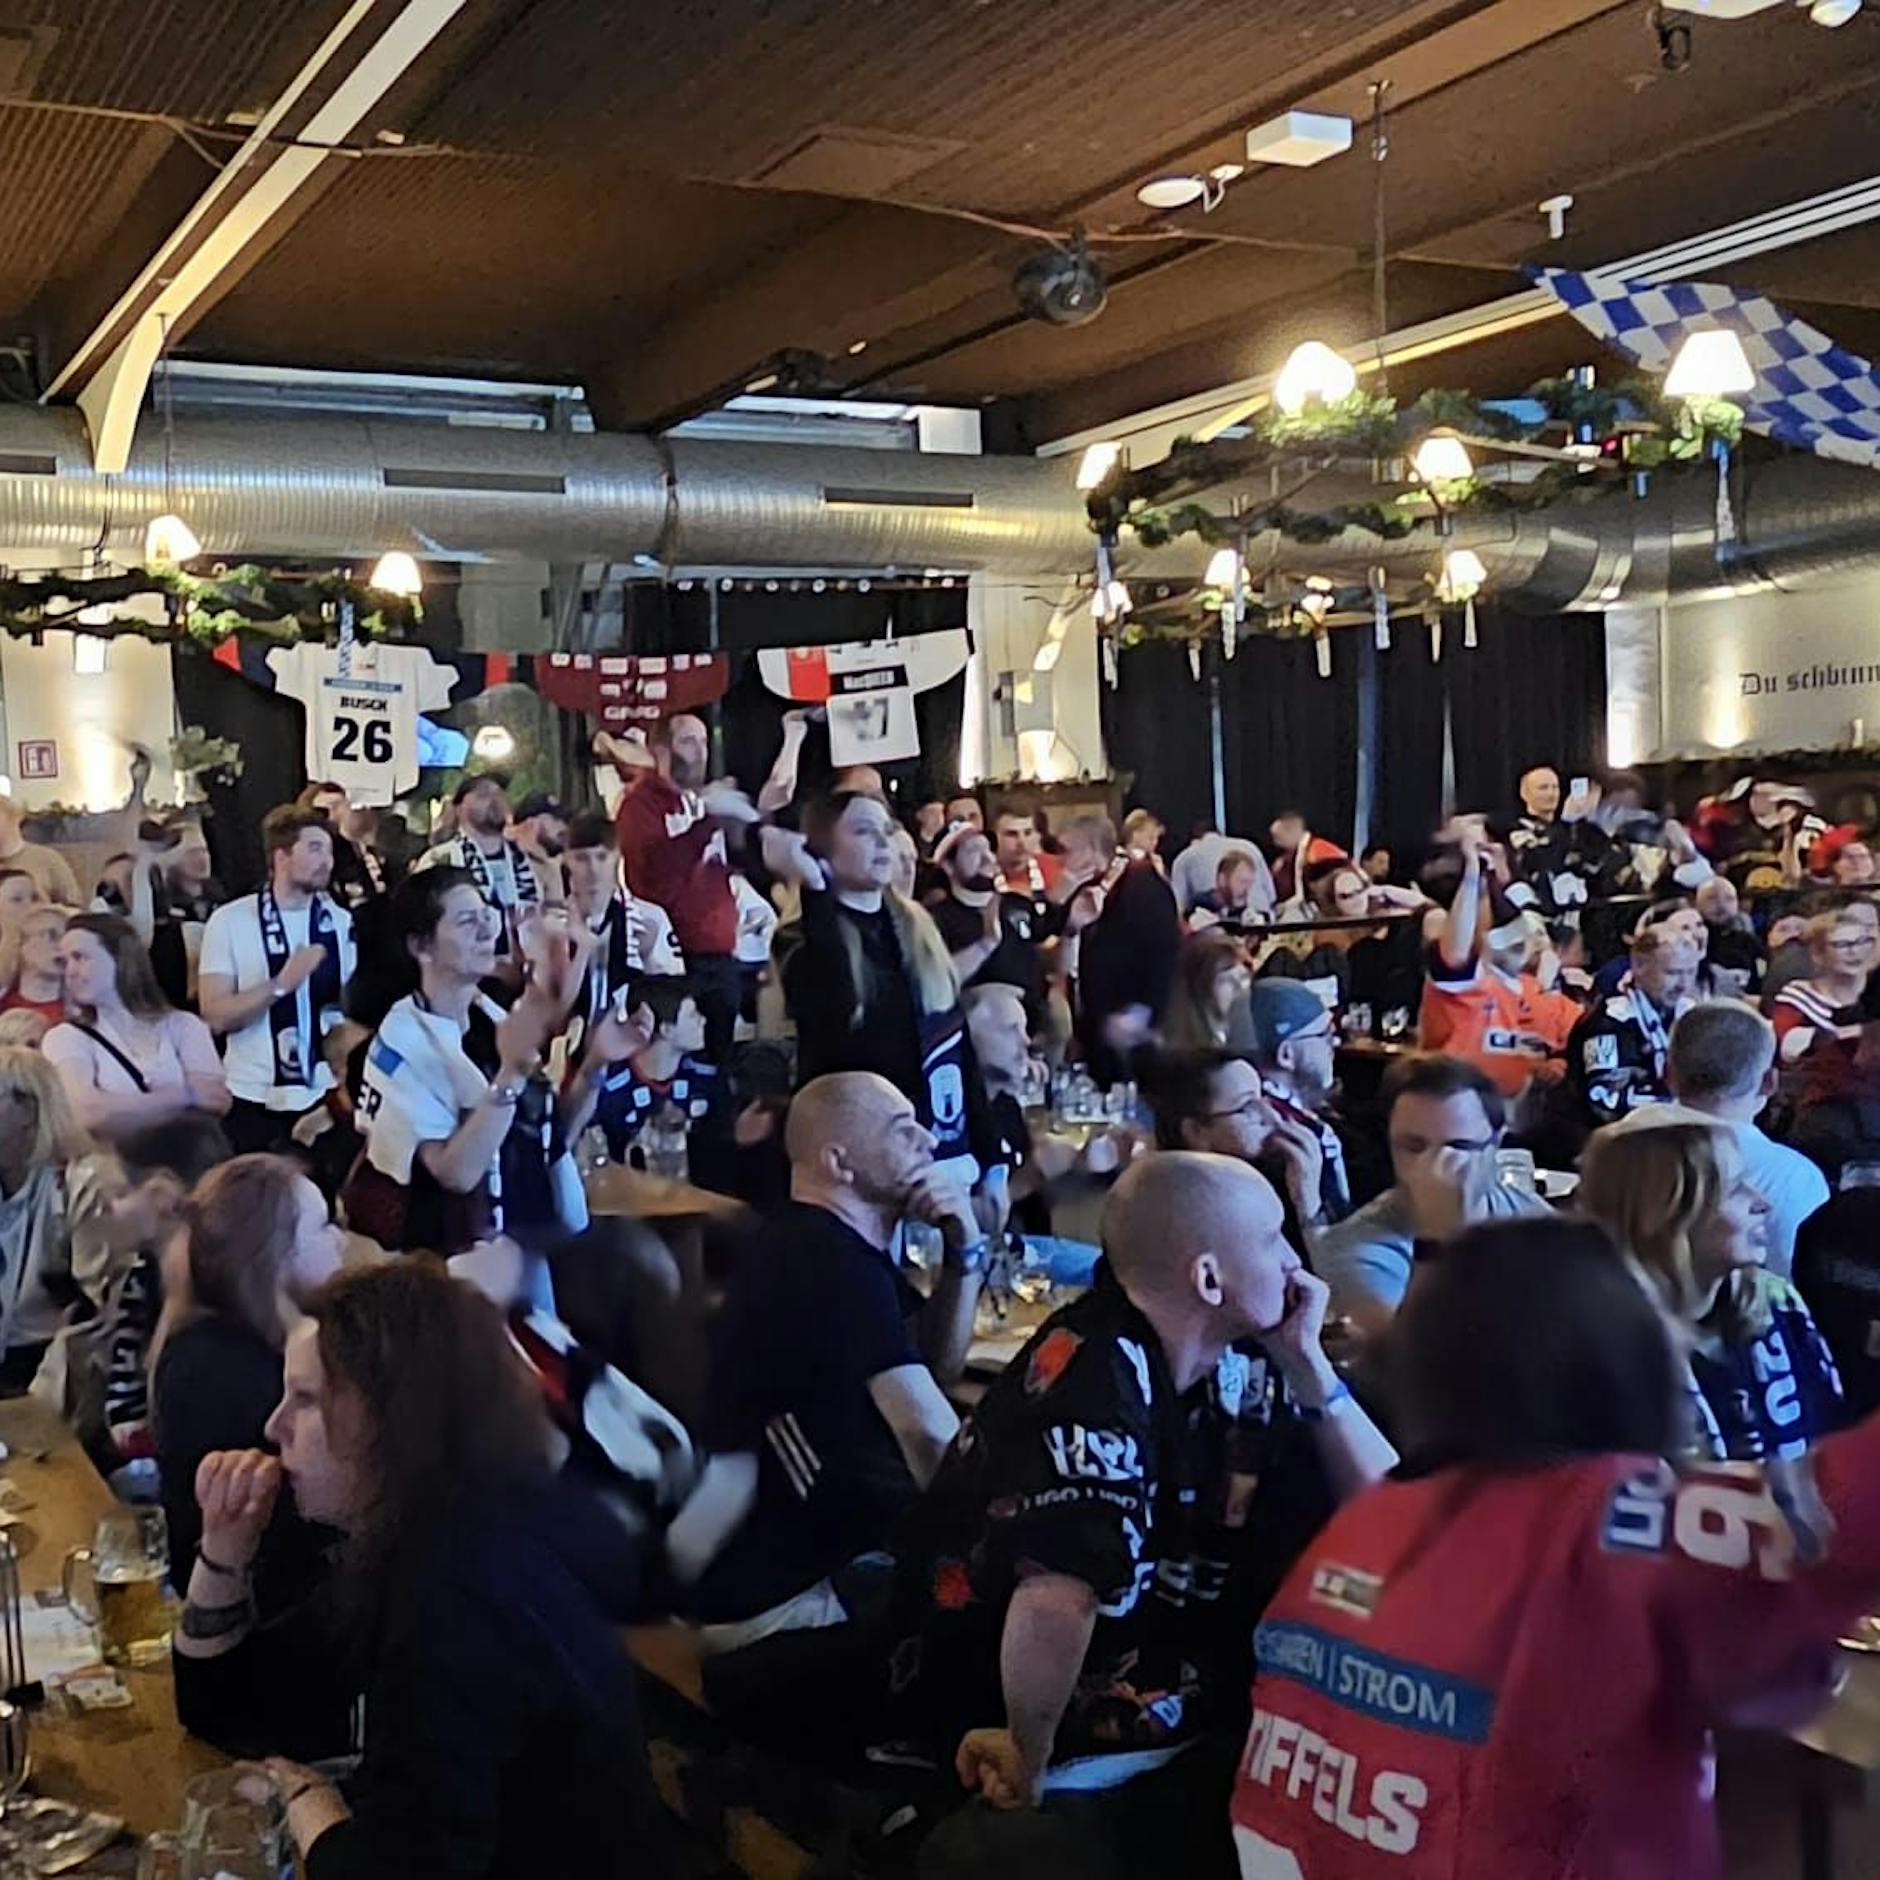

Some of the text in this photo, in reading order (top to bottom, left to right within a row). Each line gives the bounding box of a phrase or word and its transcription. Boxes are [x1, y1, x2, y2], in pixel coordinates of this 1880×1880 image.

[1739, 672, 1777, 695] Du
[331, 716, 393, 763] 26
[1339, 1656, 1455, 1727] STROM
